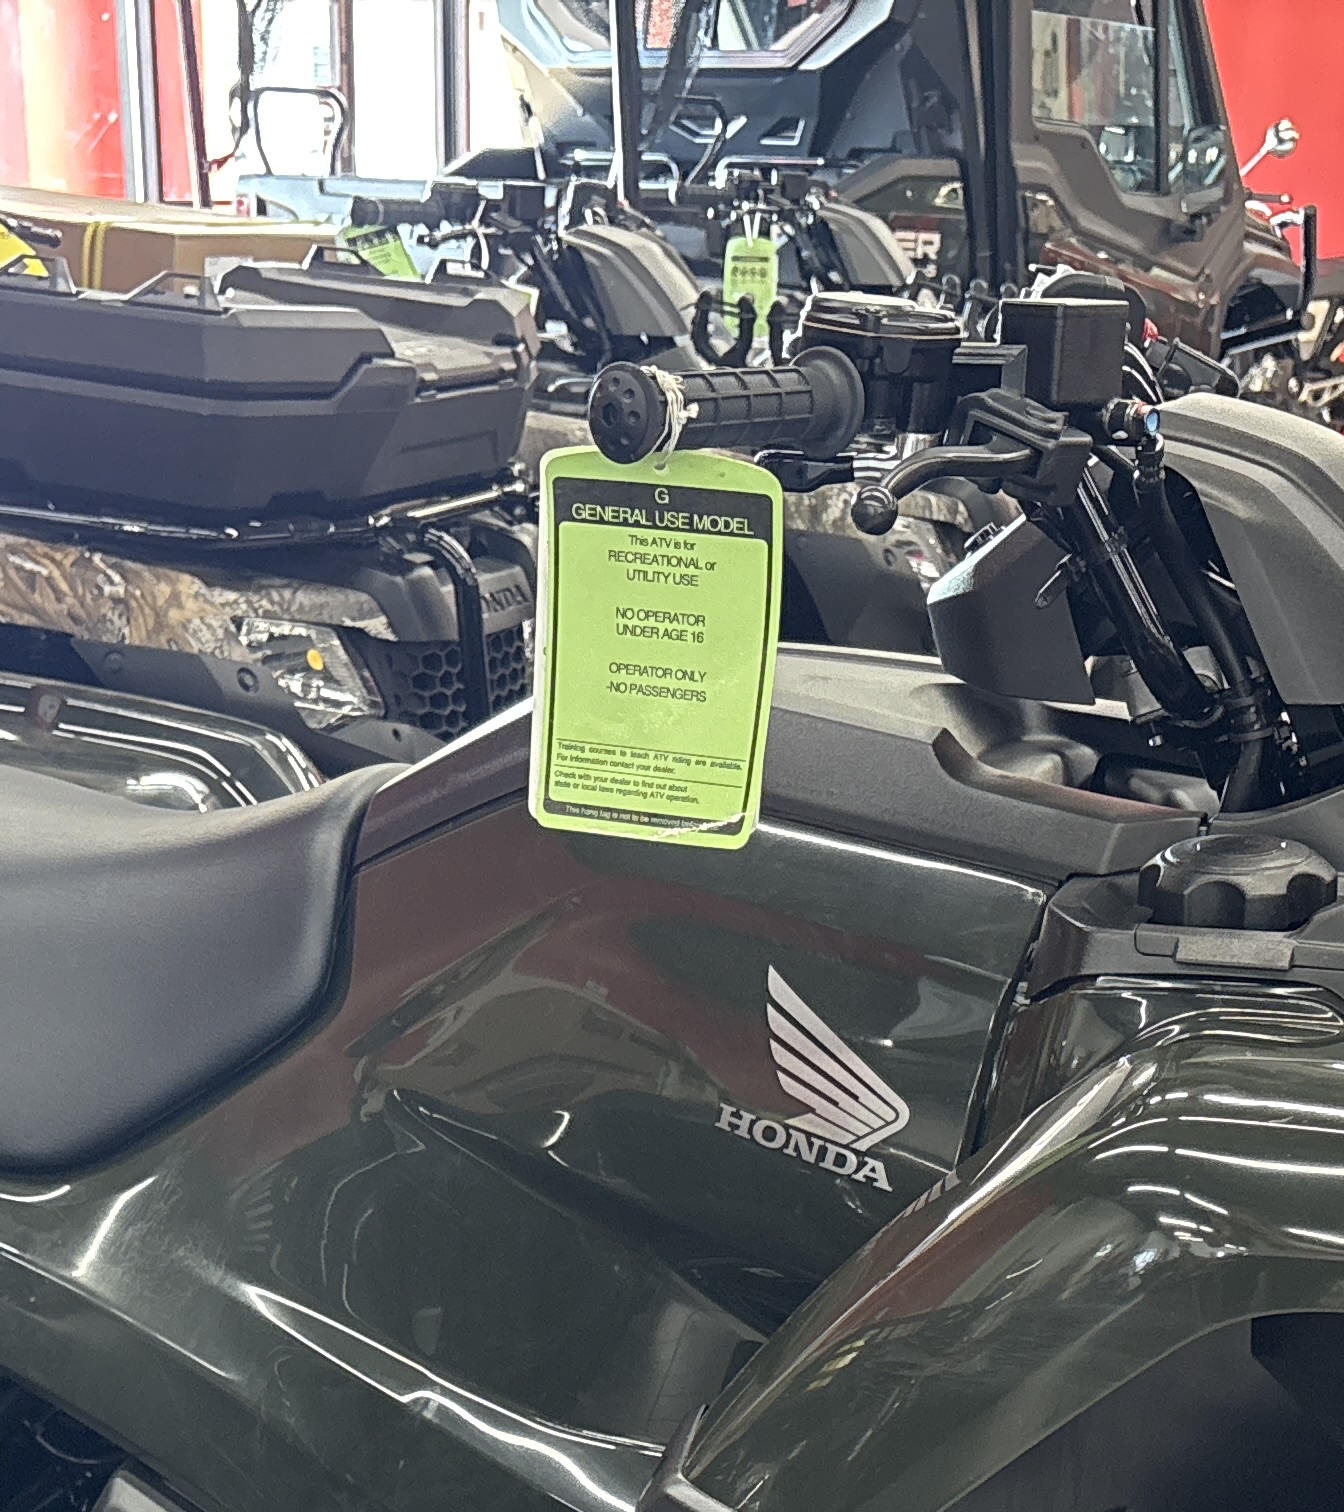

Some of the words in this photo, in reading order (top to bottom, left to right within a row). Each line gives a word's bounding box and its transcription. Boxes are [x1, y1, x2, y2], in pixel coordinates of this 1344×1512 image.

[654, 487, 670, 504] G
[572, 503, 652, 525] GENERAL
[656, 510, 690, 529] USE
[693, 514, 754, 535] MODEL
[628, 534, 648, 546] This
[650, 536, 672, 548] ATV
[674, 538, 682, 549] is
[683, 539, 696, 551] for
[608, 550, 703, 570] RECREATIONAL
[705, 561, 717, 571] or
[627, 568, 670, 582] UTILITY
[672, 574, 699, 587] USE
[616, 606, 635, 620] NO
[636, 609, 705, 627] OPERATOR
[616, 623, 659, 639] UNDER
[661, 628, 688, 642] AGE
[691, 631, 705, 643] 16
[609, 662, 673, 679] OPERATOR
[675, 669, 707, 683] ONLY
[629, 683, 707, 702] PASSENGERS
[556, 753, 568, 761] For
[570, 754, 608, 767] information
[609, 760, 635, 770] contact
[635, 764, 652, 772] your
[653, 764, 676, 775] dealer.
[558, 742, 586, 754] Training
[589, 746, 616, 756] courses
[620, 749, 627, 757] to
[630, 751, 650, 760] teach
[653, 753, 669, 762] ATV
[672, 756, 692, 767] riding
[554, 770, 577, 779] Check
[577, 773, 592, 781] with
[593, 776, 609, 784] your
[609, 776, 632, 786] dealer
[633, 779, 640, 787] to
[641, 780, 655, 788] find
[656, 782, 667, 791] out
[668, 784, 688, 793] about
[554, 779, 571, 788] state
[581, 782, 597, 791] local
[599, 785, 614, 793] laws
[616, 787, 648, 799] regarding
[649, 790, 665, 799] ATV
[565, 804, 580, 814] This
[581, 806, 598, 817] hang
[599, 809, 611, 819] tag
[611, 811, 619, 819] is
[619, 812, 631, 821] not
[632, 813, 639, 822] to
[640, 814, 649, 822] be
[650, 817, 680, 828] removed
[714, 1102, 893, 1192] HONDA
